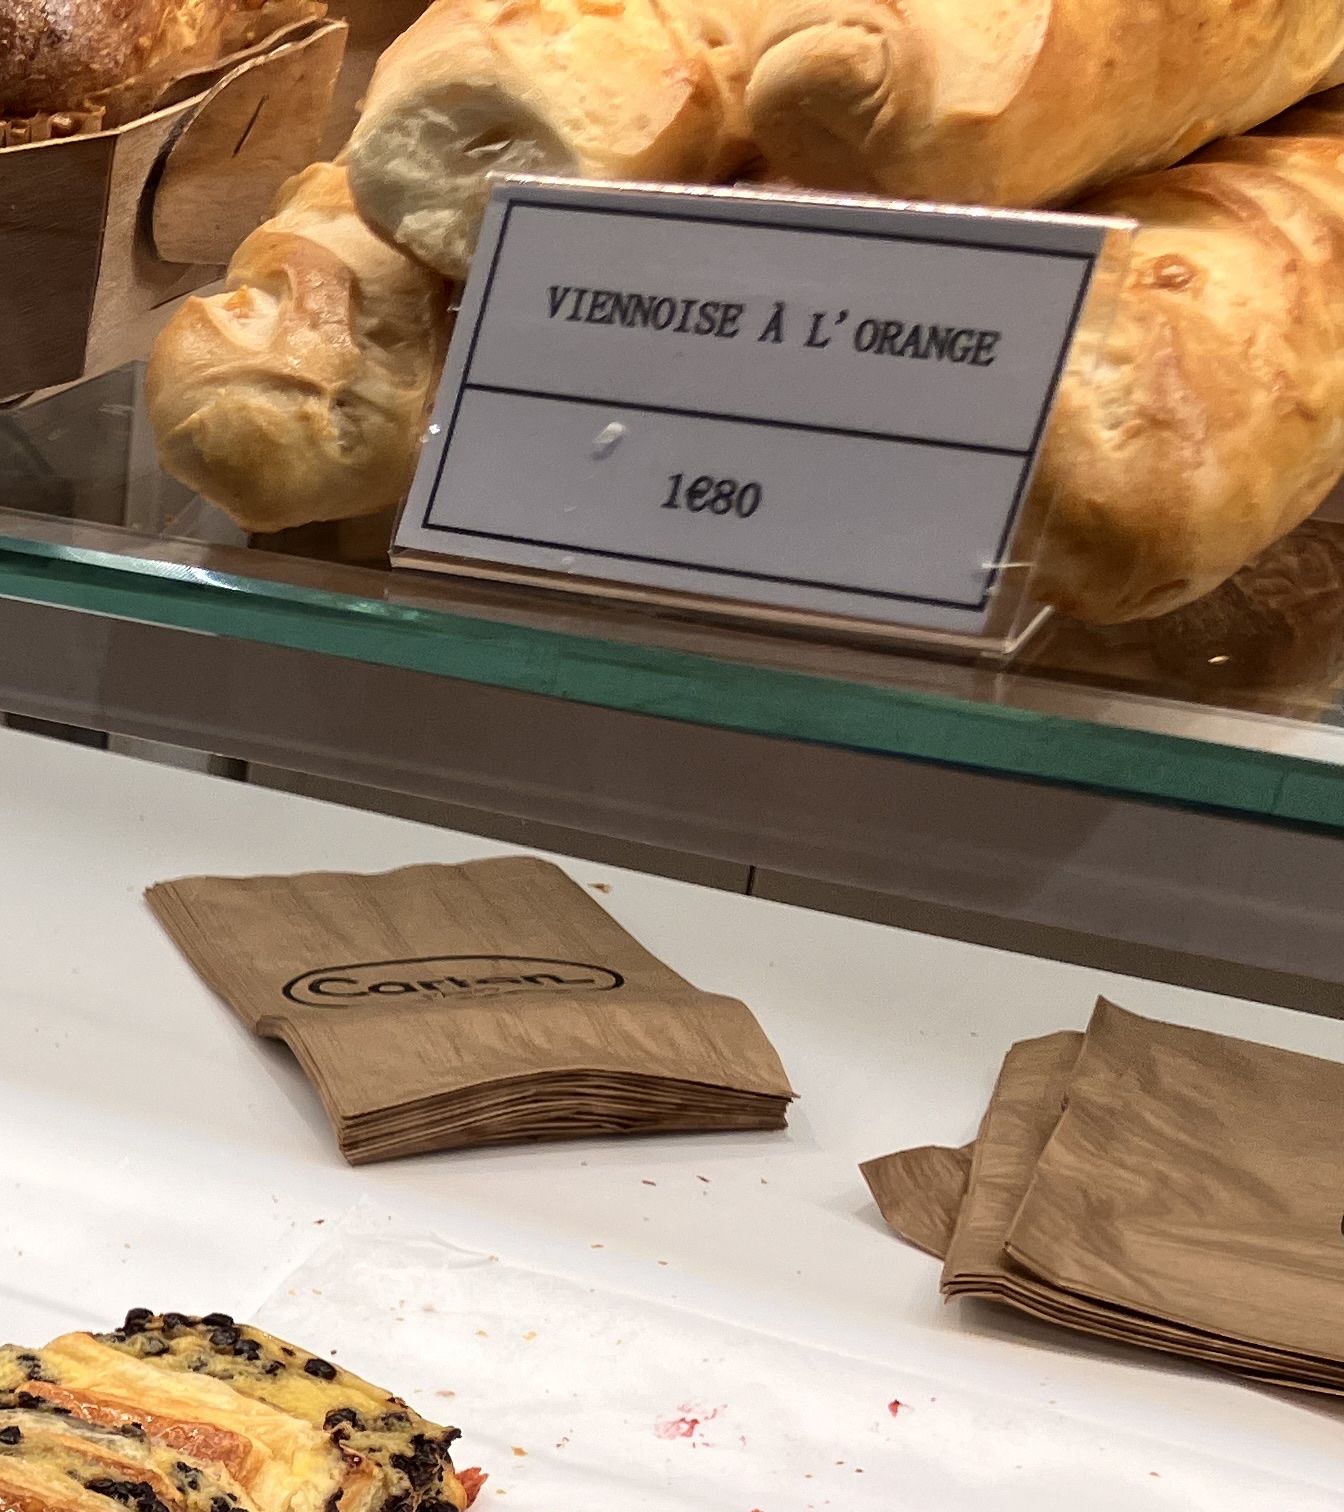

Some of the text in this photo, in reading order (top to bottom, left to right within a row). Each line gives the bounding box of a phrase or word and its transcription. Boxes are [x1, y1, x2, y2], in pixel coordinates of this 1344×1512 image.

[547, 285, 1001, 366] VIENNOISE À L'ORANGE
[661, 472, 762, 518] 1€80
